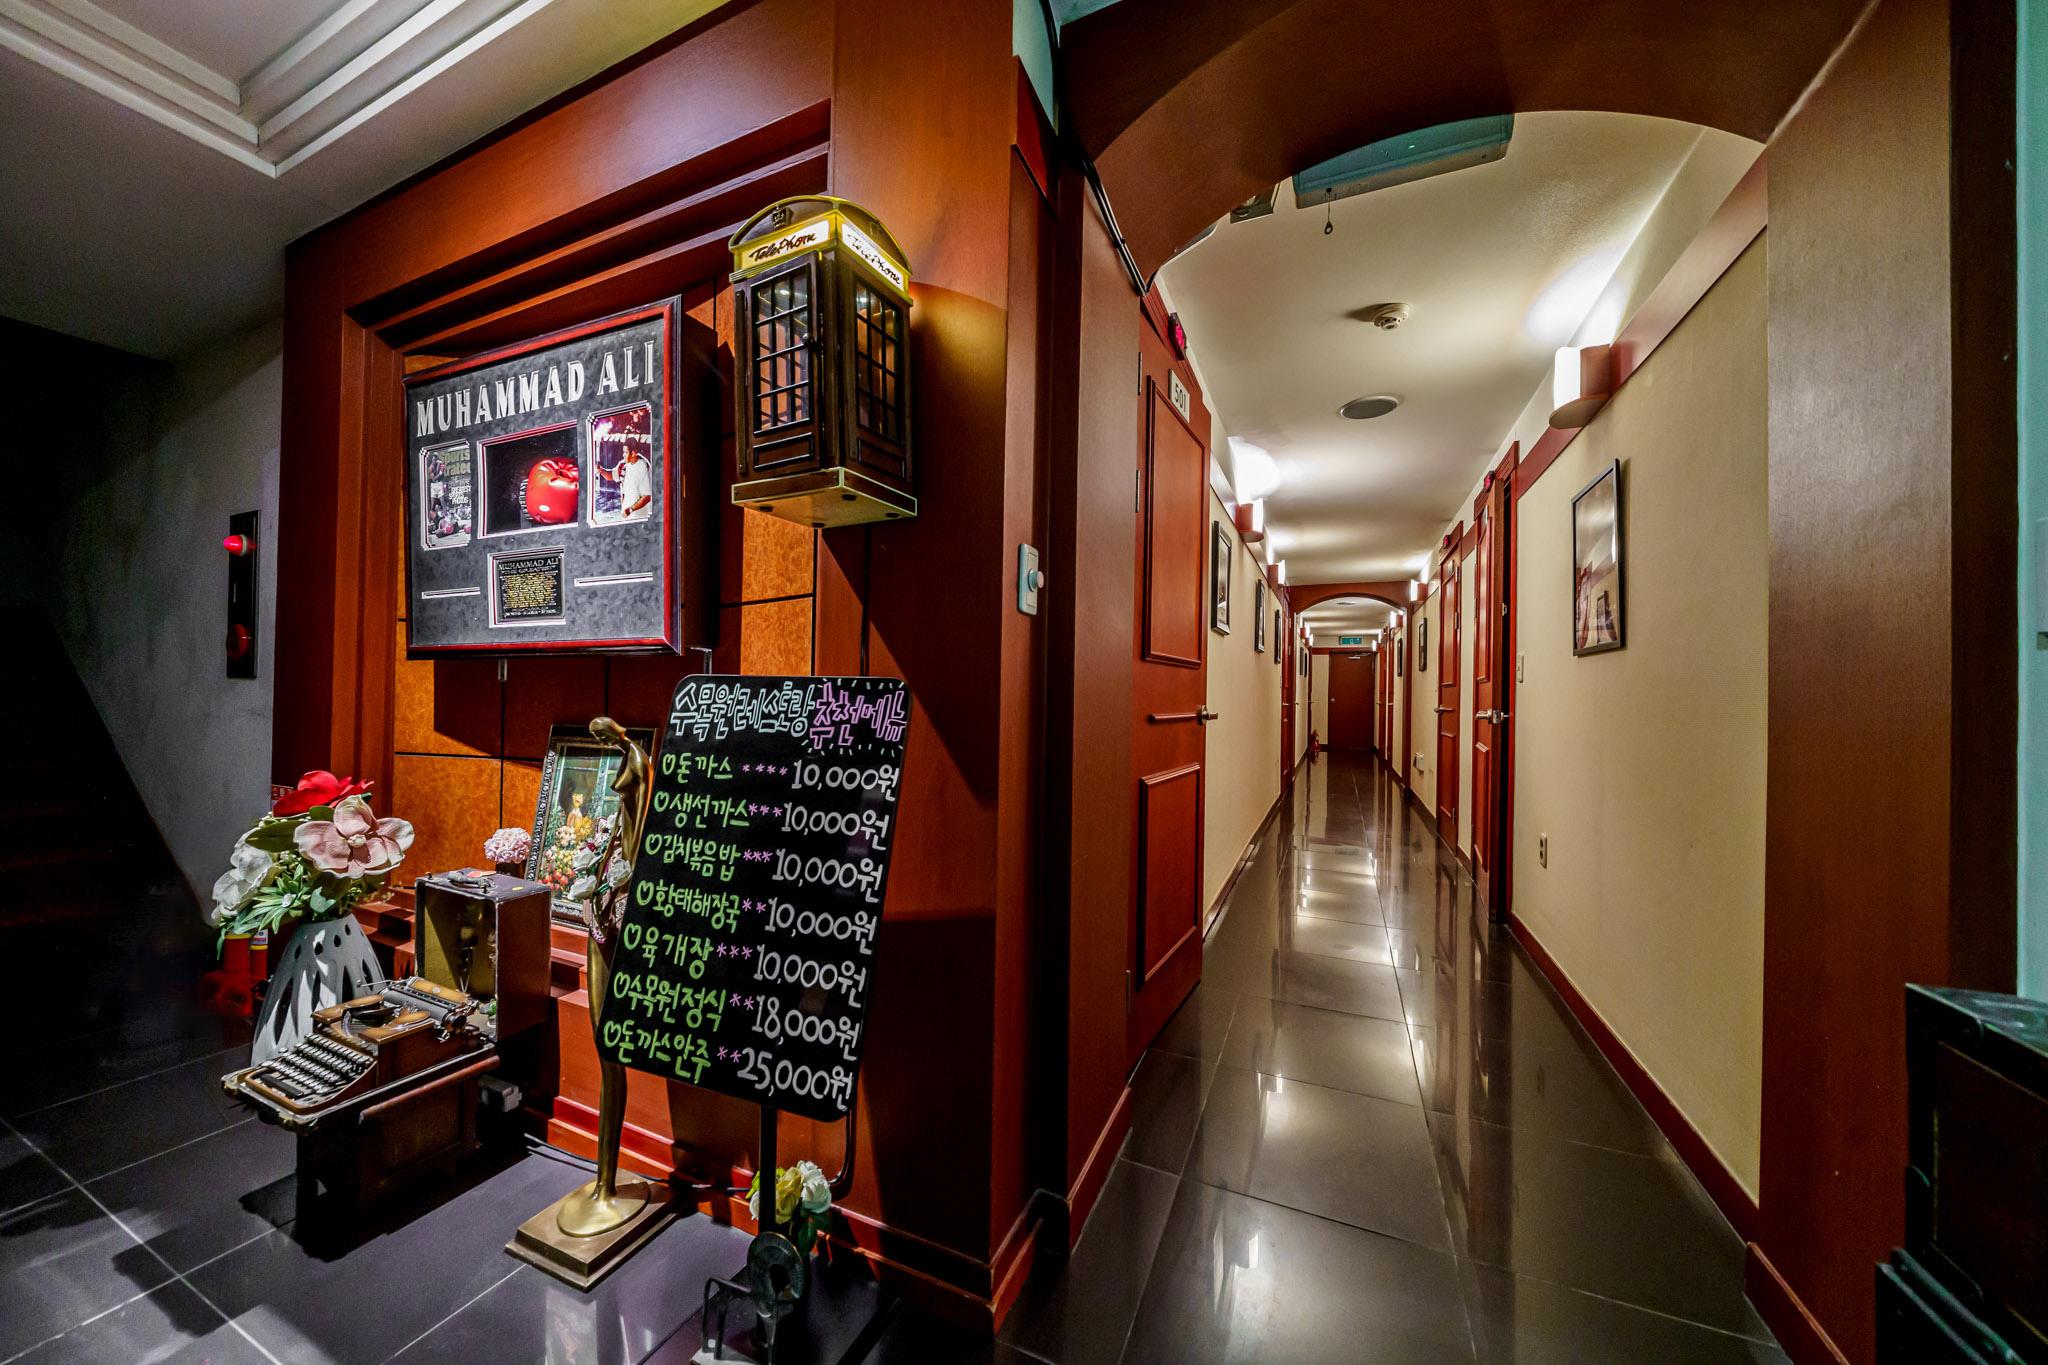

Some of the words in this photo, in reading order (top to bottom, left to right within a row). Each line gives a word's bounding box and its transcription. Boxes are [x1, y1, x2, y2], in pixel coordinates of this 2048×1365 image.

[416, 360, 586, 437] MUHAMMAD
[597, 340, 656, 396] ALI
[498, 559, 544, 571] MUHAMMAD
[810, 682, 908, 750] 추천메뉴
[677, 753, 733, 784] 돈까스
[792, 760, 900, 802] 10,000원
[670, 791, 750, 828] 생선까스
[781, 802, 890, 851] 10,000원
[663, 834, 741, 882] 김치볶음밥
[772, 849, 884, 904] 10,000원
[653, 880, 740, 934] 황태해장국
[765, 897, 877, 955] 10,000원
[642, 926, 713, 980] 육개장
[753, 944, 867, 1008] 10,000원
[752, 995, 860, 1061] 18,000원
[737, 1047, 854, 1112] 25,000원
